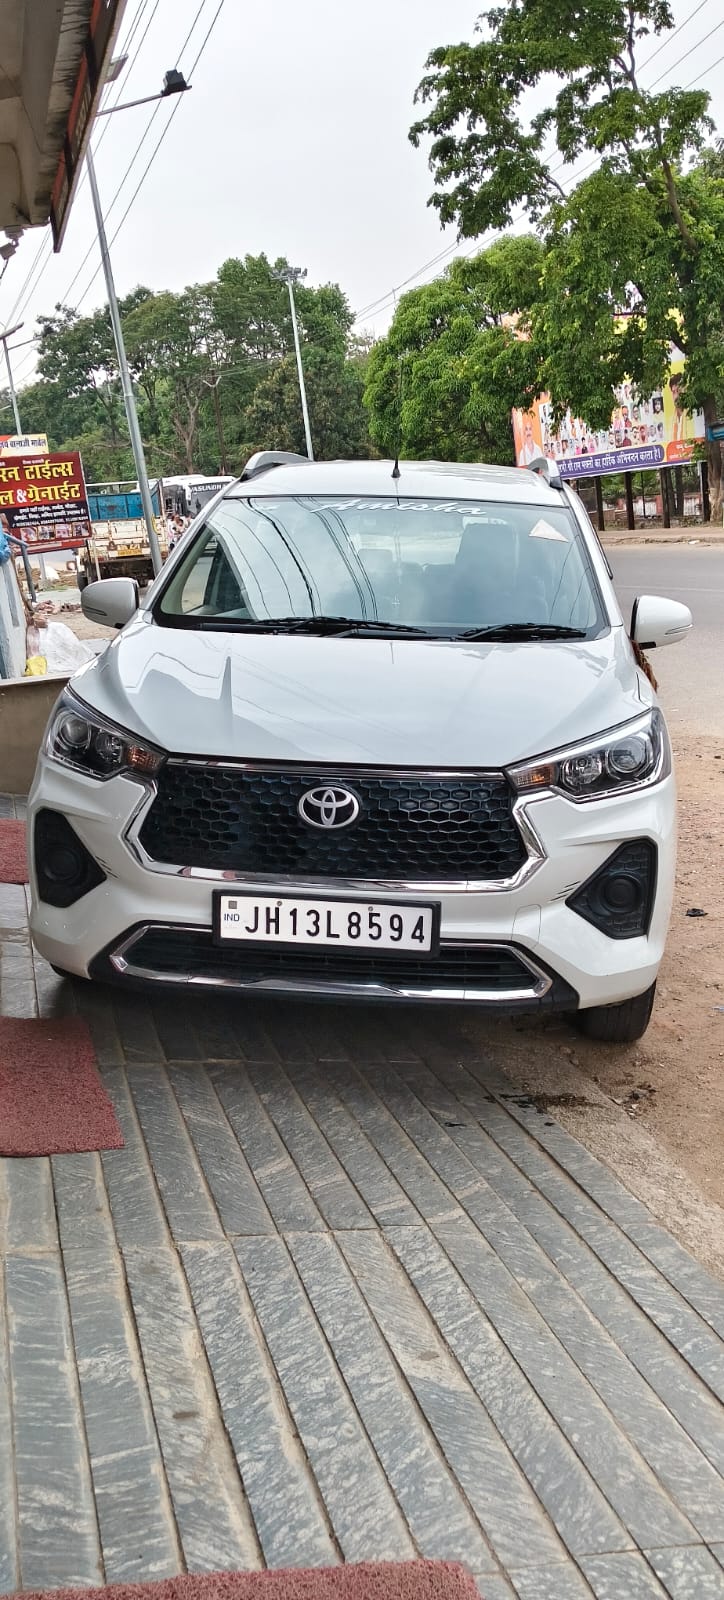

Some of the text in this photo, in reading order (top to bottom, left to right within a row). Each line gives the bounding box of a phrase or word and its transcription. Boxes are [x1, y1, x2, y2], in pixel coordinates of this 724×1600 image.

[23, 459, 75, 480] टाईल्स
[309, 498, 487, 515] Amisha
[223, 913, 240, 922] IND
[244, 905, 425, 944] JH13L8594
